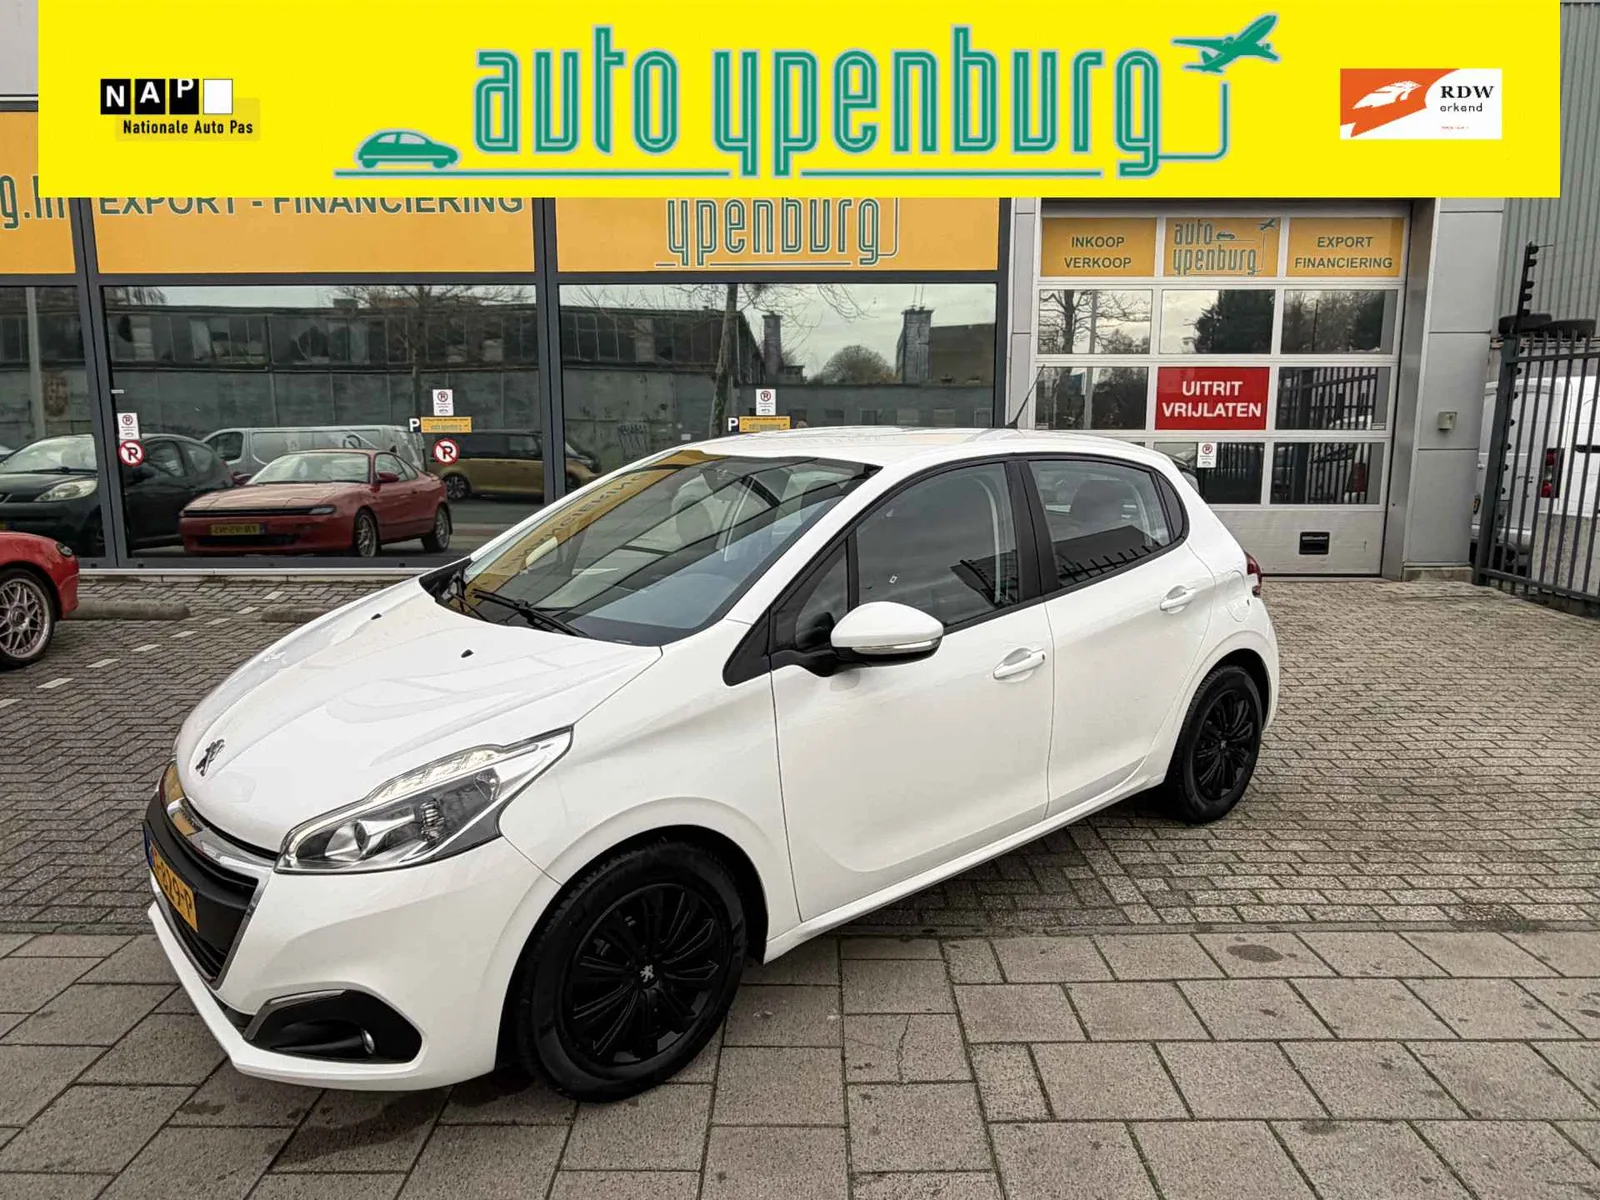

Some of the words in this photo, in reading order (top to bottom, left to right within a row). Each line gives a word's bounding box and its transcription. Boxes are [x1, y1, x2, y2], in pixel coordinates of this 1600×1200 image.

[667, 197, 880, 266] ypenburg
[1174, 219, 1213, 246] auto
[1071, 236, 1125, 248] INKOOP
[1317, 236, 1373, 248] EXPORT
[1064, 257, 1132, 269] VERKOOP
[1173, 245, 1257, 275] ypenburg
[1295, 257, 1393, 269] FINANCIERING
[1182, 380, 1243, 396] UITRIT
[1162, 402, 1262, 418] VRIJLATEN
